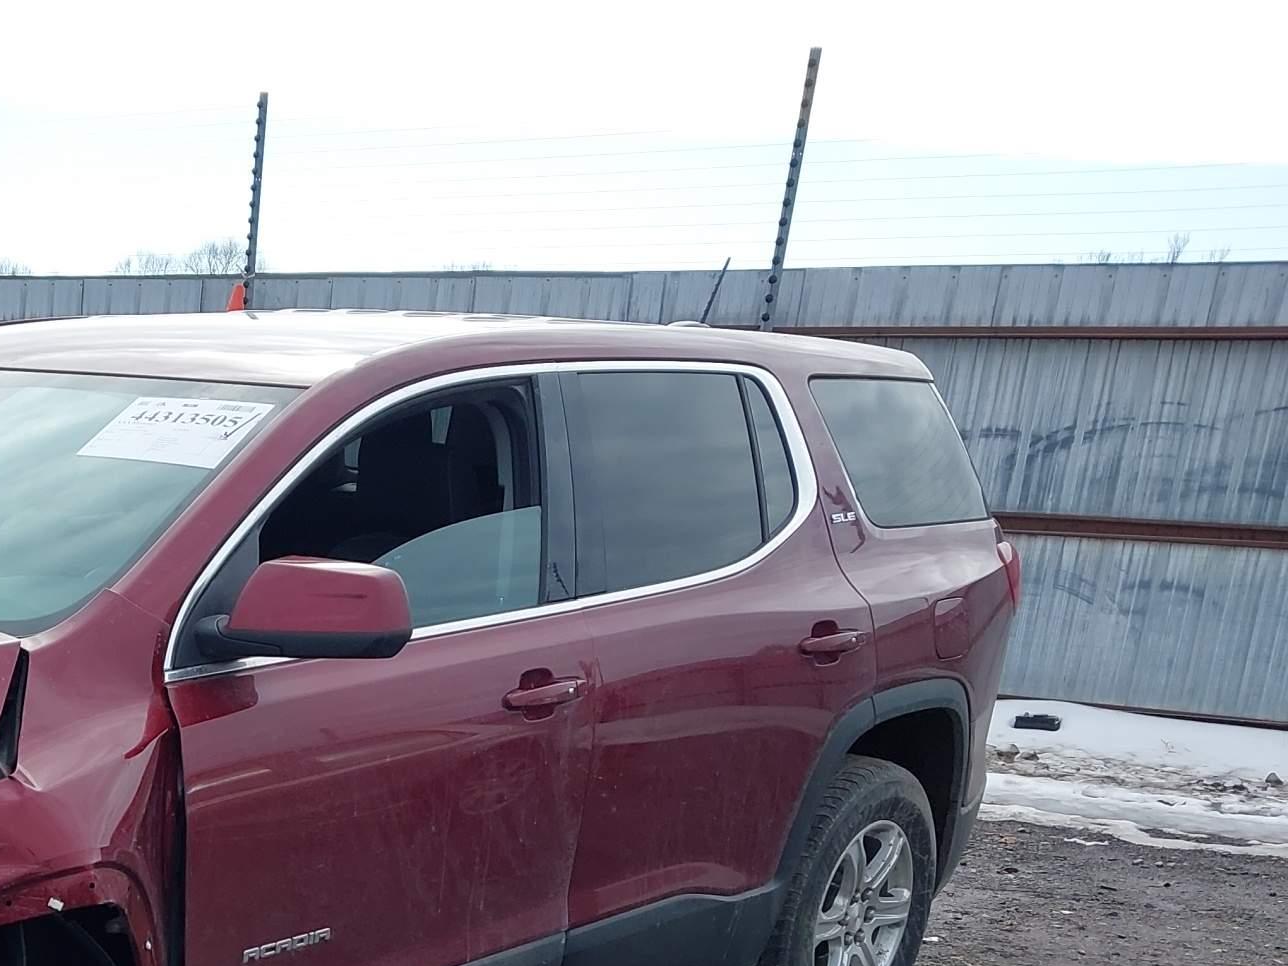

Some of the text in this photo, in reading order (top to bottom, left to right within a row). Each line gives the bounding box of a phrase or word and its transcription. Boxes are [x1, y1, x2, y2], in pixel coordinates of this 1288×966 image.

[130, 410, 243, 428] 44313505
[831, 511, 857, 524] SLE
[242, 927, 331, 963] ACADIA
